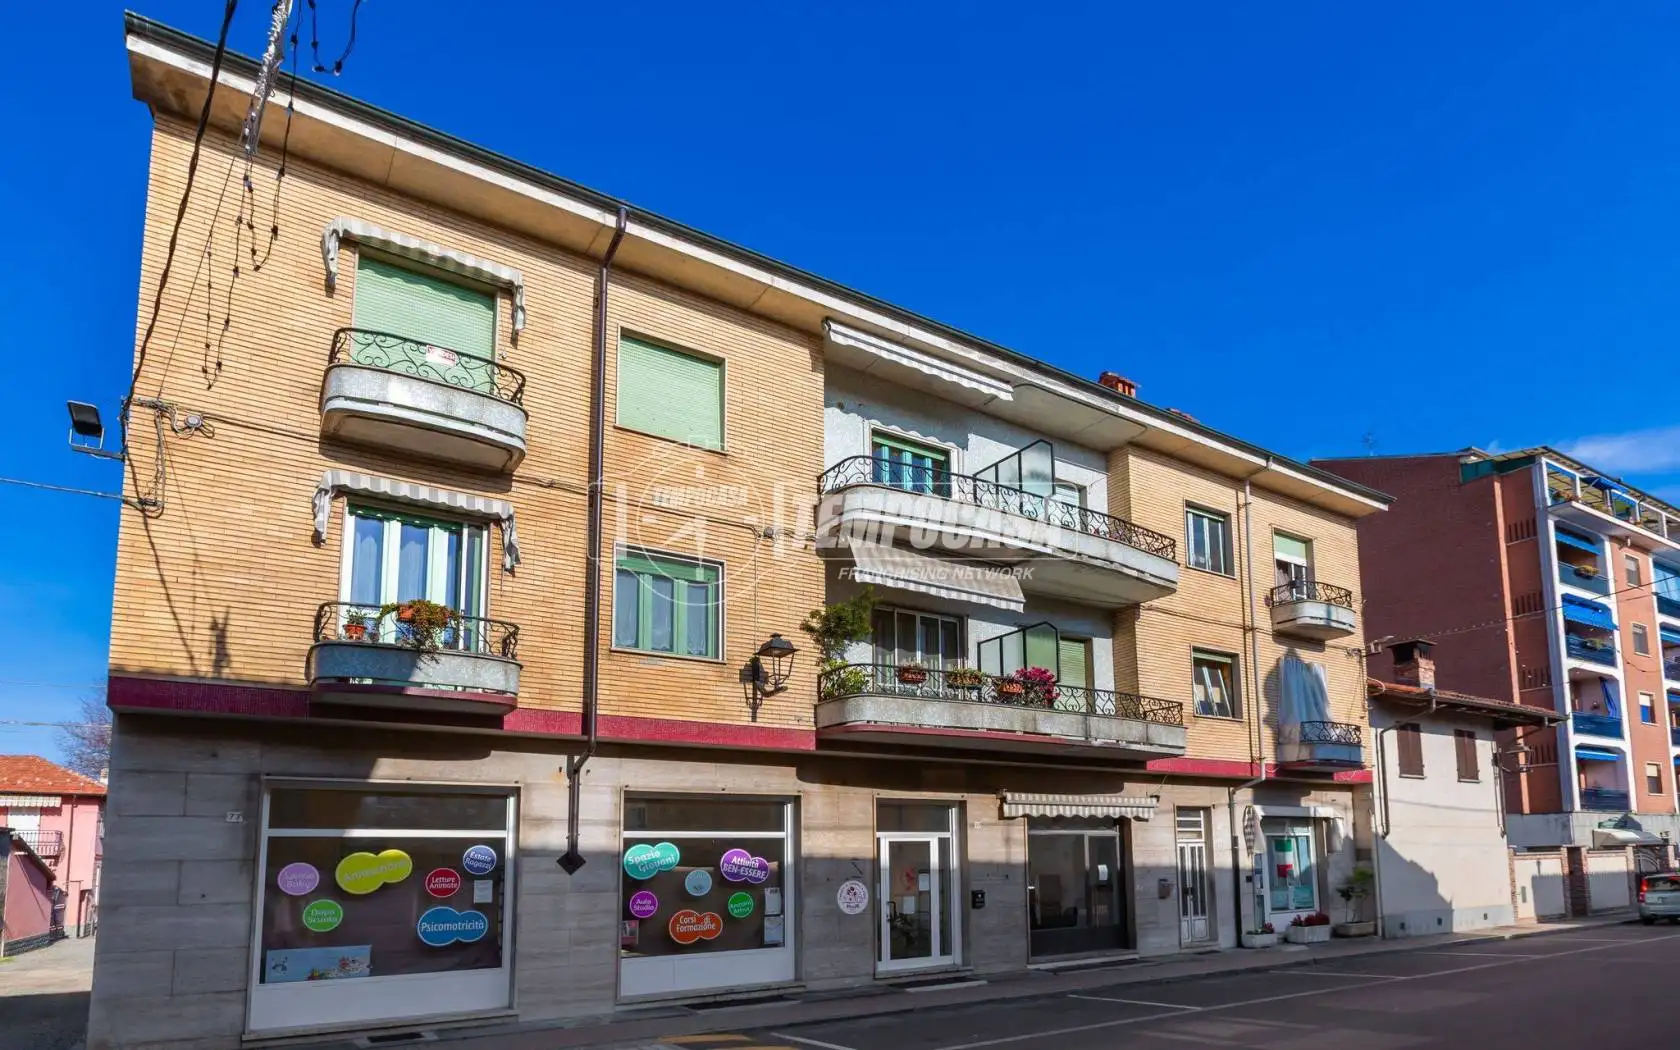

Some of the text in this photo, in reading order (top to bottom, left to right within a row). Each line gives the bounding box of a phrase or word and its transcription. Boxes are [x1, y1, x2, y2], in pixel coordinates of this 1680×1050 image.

[469, 851, 492, 862] Estate
[627, 850, 661, 865] Spazio
[638, 853, 676, 872] Giovani
[731, 856, 759, 869] Attività
[723, 863, 767, 880] BEN-ESSERE
[679, 914, 711, 924] Corsi di
[420, 919, 485, 933] Psicomotricità
[676, 922, 716, 933] Formazione
